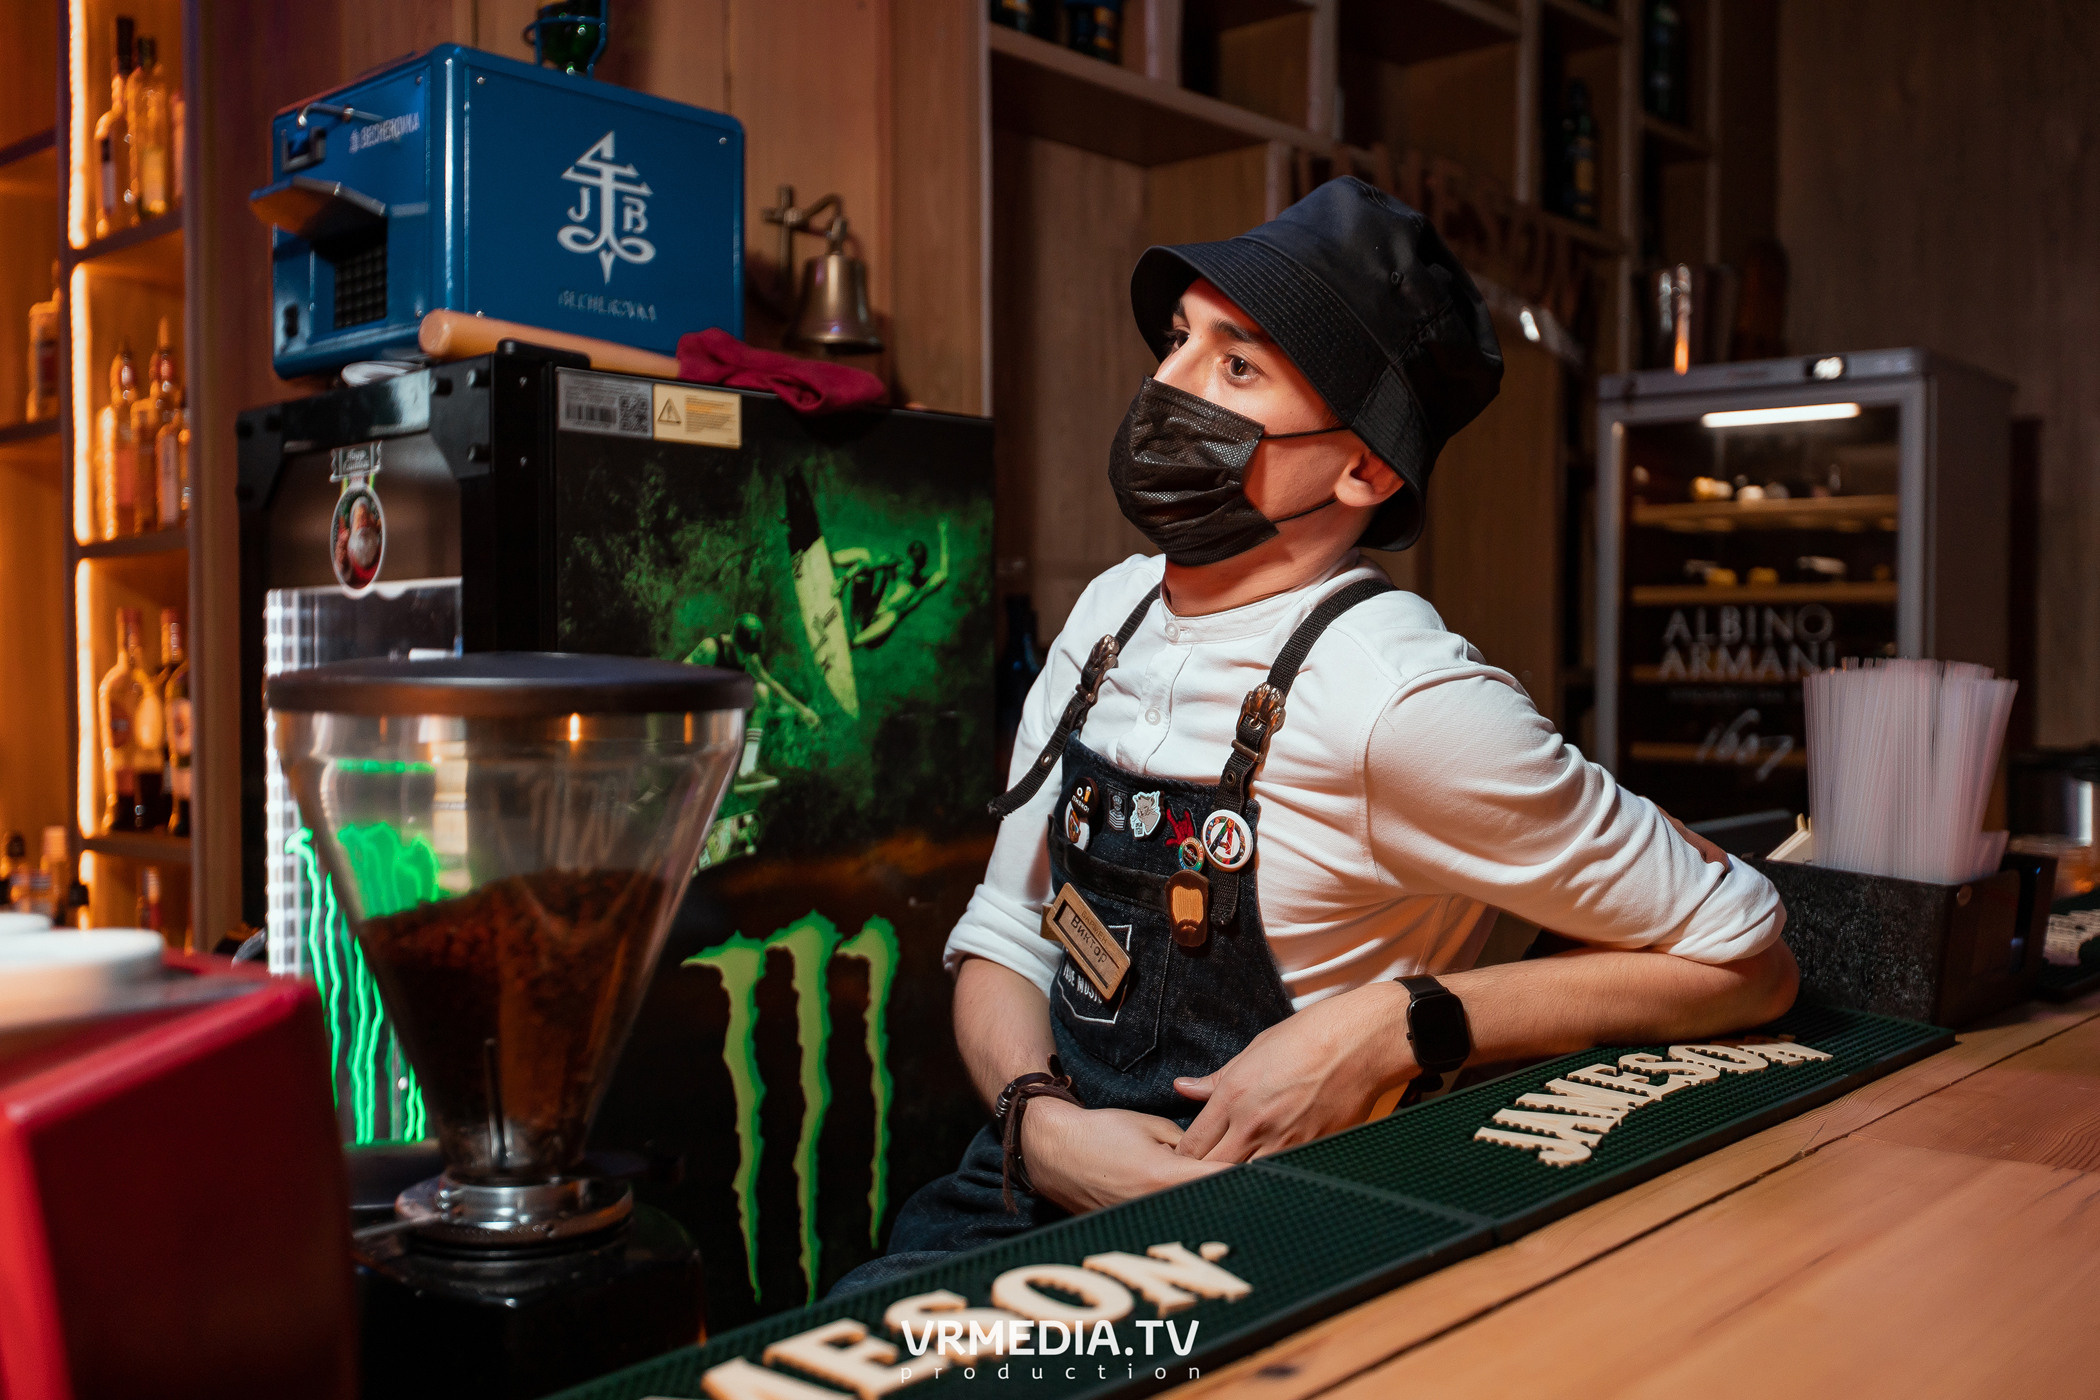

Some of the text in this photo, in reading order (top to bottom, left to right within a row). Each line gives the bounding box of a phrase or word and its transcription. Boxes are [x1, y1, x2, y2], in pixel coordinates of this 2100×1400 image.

[1662, 604, 1834, 645] ALBINO
[1070, 915, 1108, 963] Виктор
[1473, 1034, 1834, 1169] JAMESON
